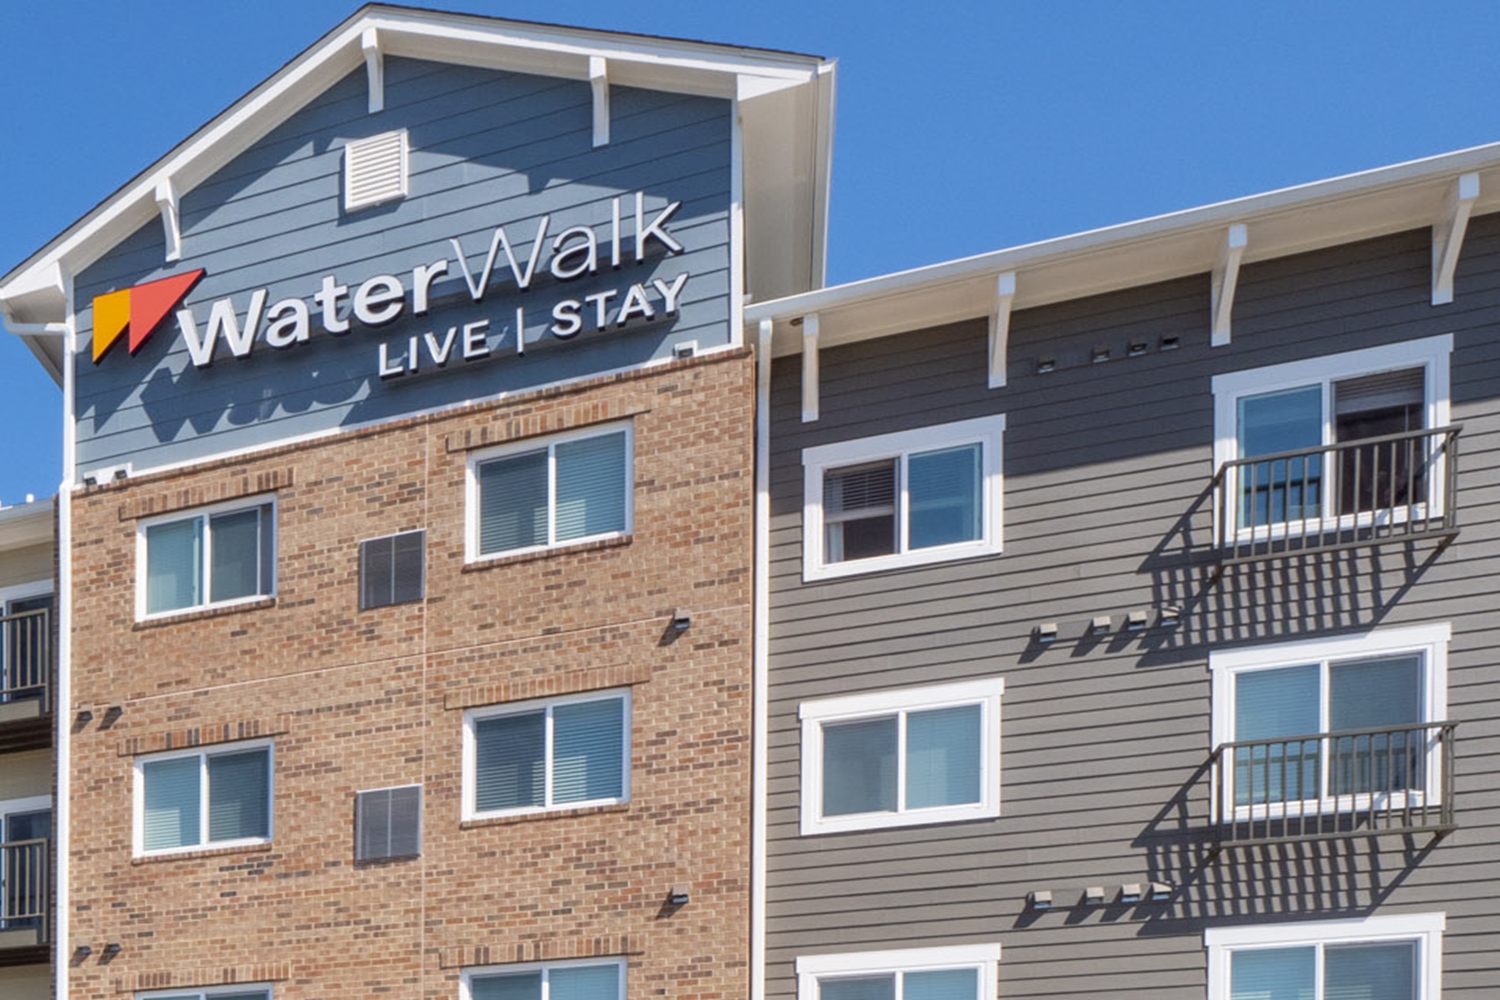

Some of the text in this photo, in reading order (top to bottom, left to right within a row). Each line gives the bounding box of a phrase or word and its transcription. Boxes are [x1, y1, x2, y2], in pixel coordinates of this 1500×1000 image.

[176, 190, 685, 368] WaterWalk
[378, 319, 491, 379] LIVE
[549, 272, 690, 339] STAY
